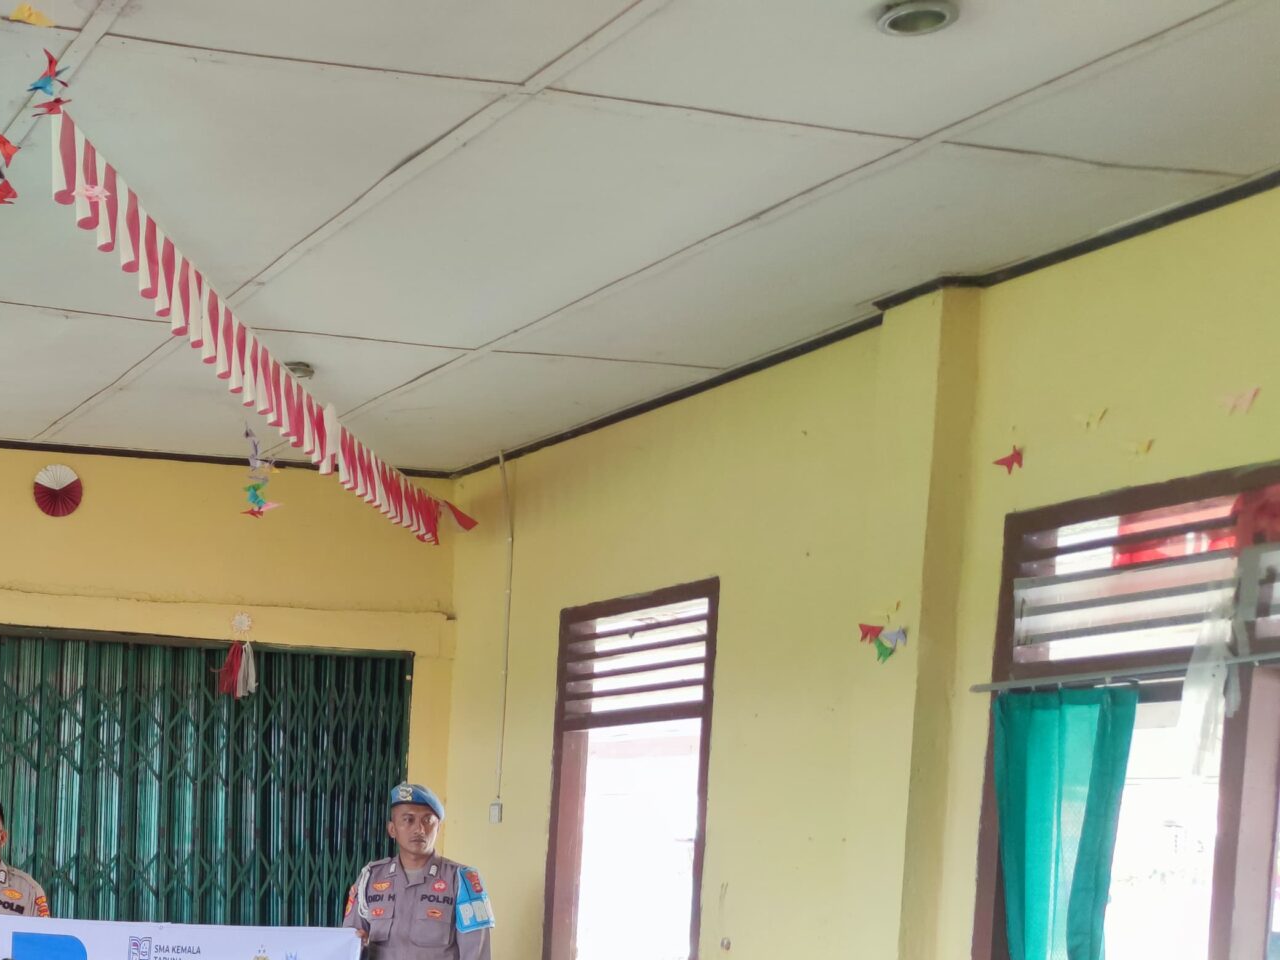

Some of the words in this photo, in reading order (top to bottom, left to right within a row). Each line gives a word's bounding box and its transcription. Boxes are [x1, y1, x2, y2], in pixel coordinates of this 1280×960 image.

[367, 894, 384, 903] DIDI
[420, 894, 454, 905] POLRI
[154, 944, 170, 954] SMA
[171, 945, 201, 955] KEMALA
